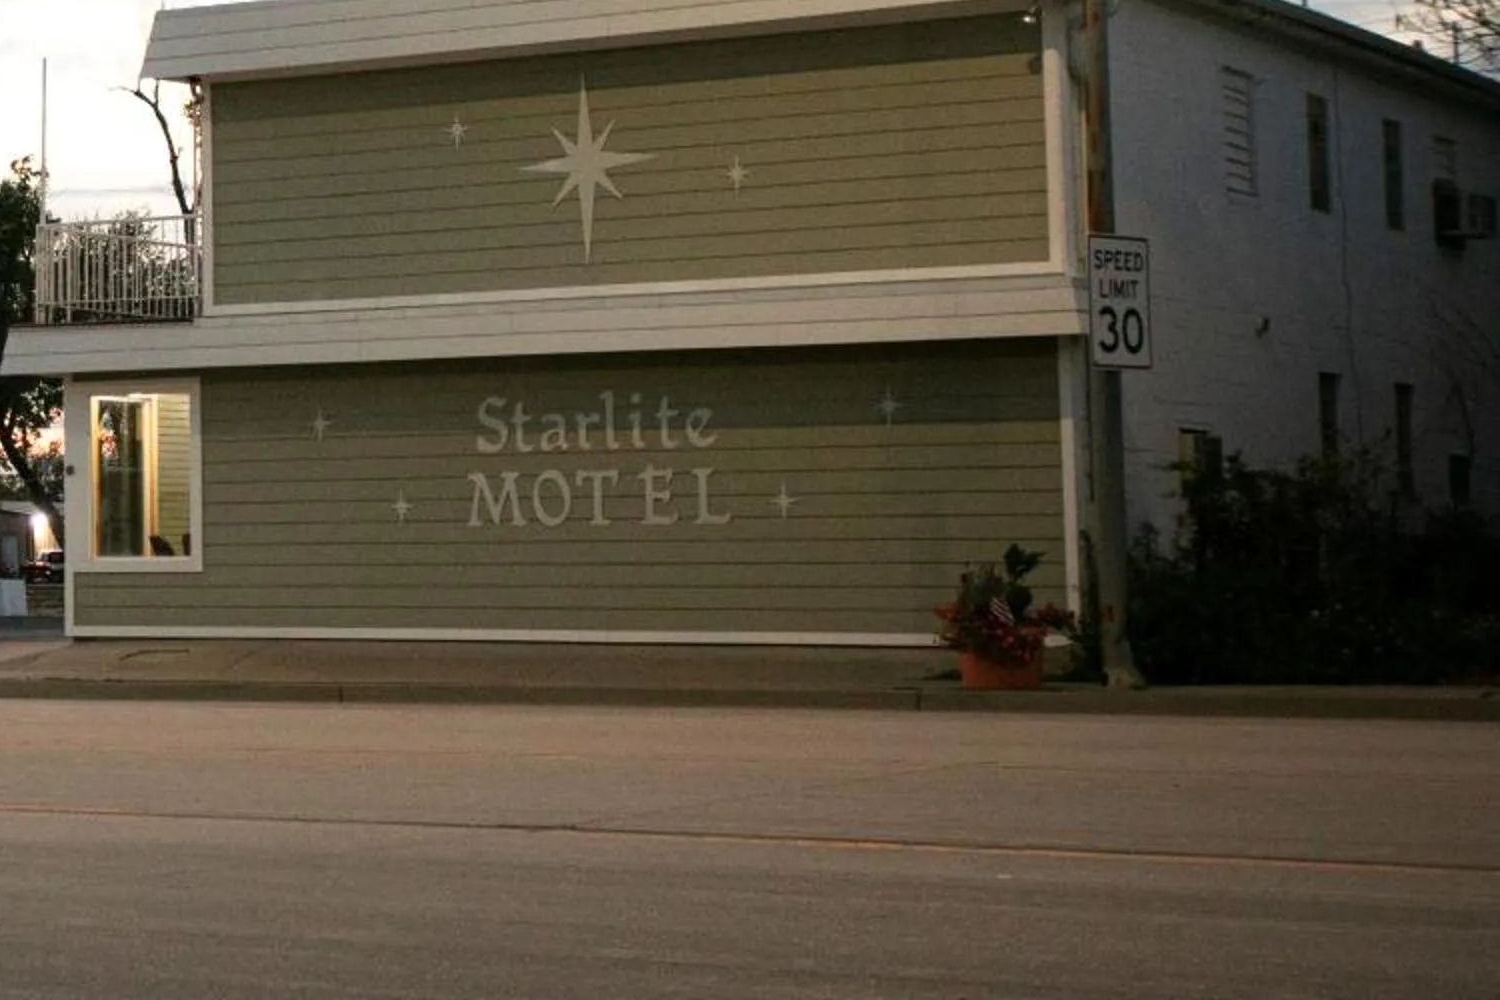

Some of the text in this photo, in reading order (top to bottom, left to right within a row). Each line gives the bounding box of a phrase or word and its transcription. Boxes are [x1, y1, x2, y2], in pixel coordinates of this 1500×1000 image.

[1093, 248, 1143, 272] SPEED
[1099, 278, 1140, 299] LIMIT
[1098, 305, 1143, 355] 30
[476, 389, 718, 452] Starlite
[466, 463, 732, 527] MOTEL
